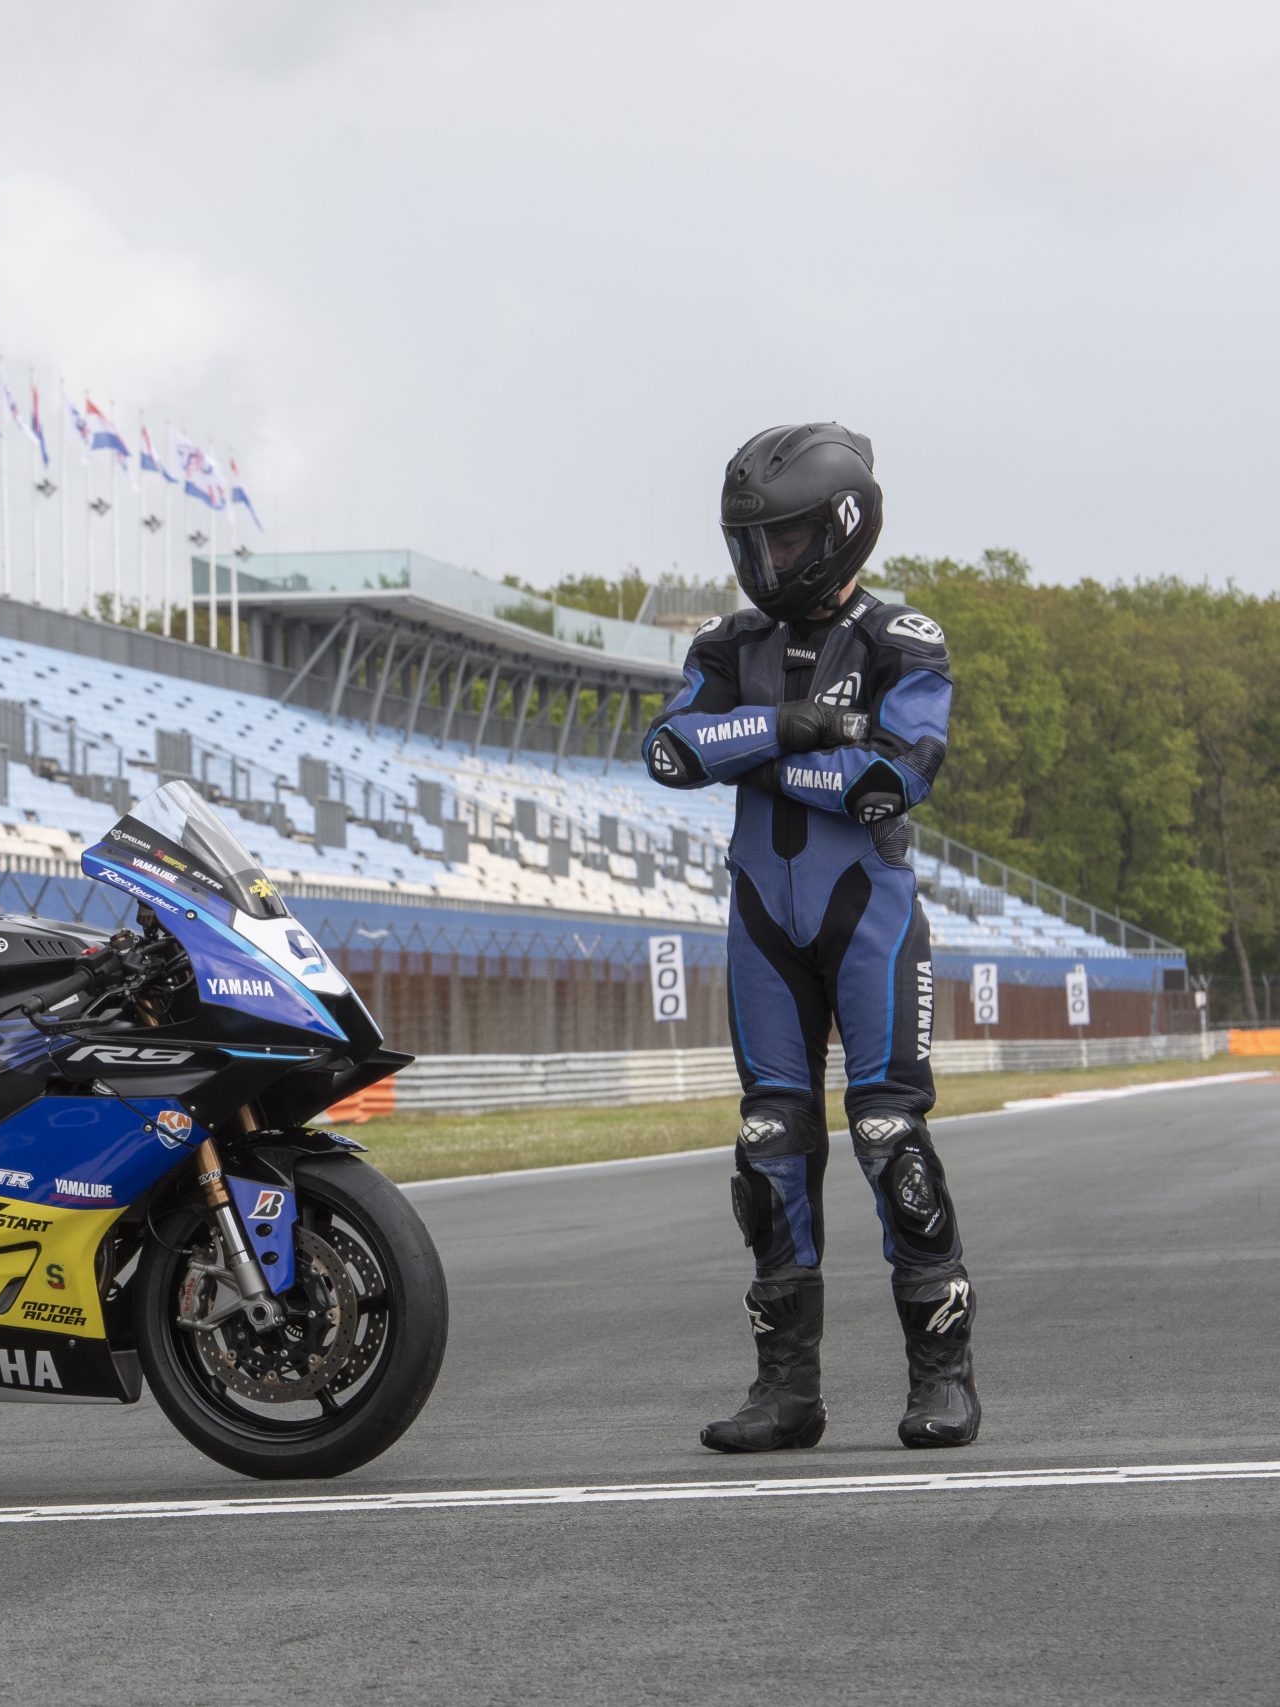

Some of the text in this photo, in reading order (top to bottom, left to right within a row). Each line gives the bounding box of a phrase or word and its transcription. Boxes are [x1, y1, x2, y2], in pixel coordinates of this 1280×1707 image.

[840, 603, 868, 628] YAAHA
[786, 648, 816, 661] YAMAHA
[696, 716, 768, 745] YAMAHA
[786, 766, 843, 791] YAMAHA
[121, 832, 151, 850] SPEELMAN
[132, 857, 179, 884] YAMALUBE
[192, 870, 224, 890] GYTR
[128, 884, 155, 900] Your
[206, 978, 274, 997] YAMAHA
[657, 941, 679, 1016] 200
[979, 967, 994, 1021] 100
[1071, 982, 1085, 1014] 50
[917, 960, 934, 1061] YAMAHA
[67, 1045, 196, 1065] R9
[55, 1178, 113, 1198] YAMALUBE
[21, 1301, 83, 1317] MOTOR
[23, 1310, 87, 1327] RIJDER
